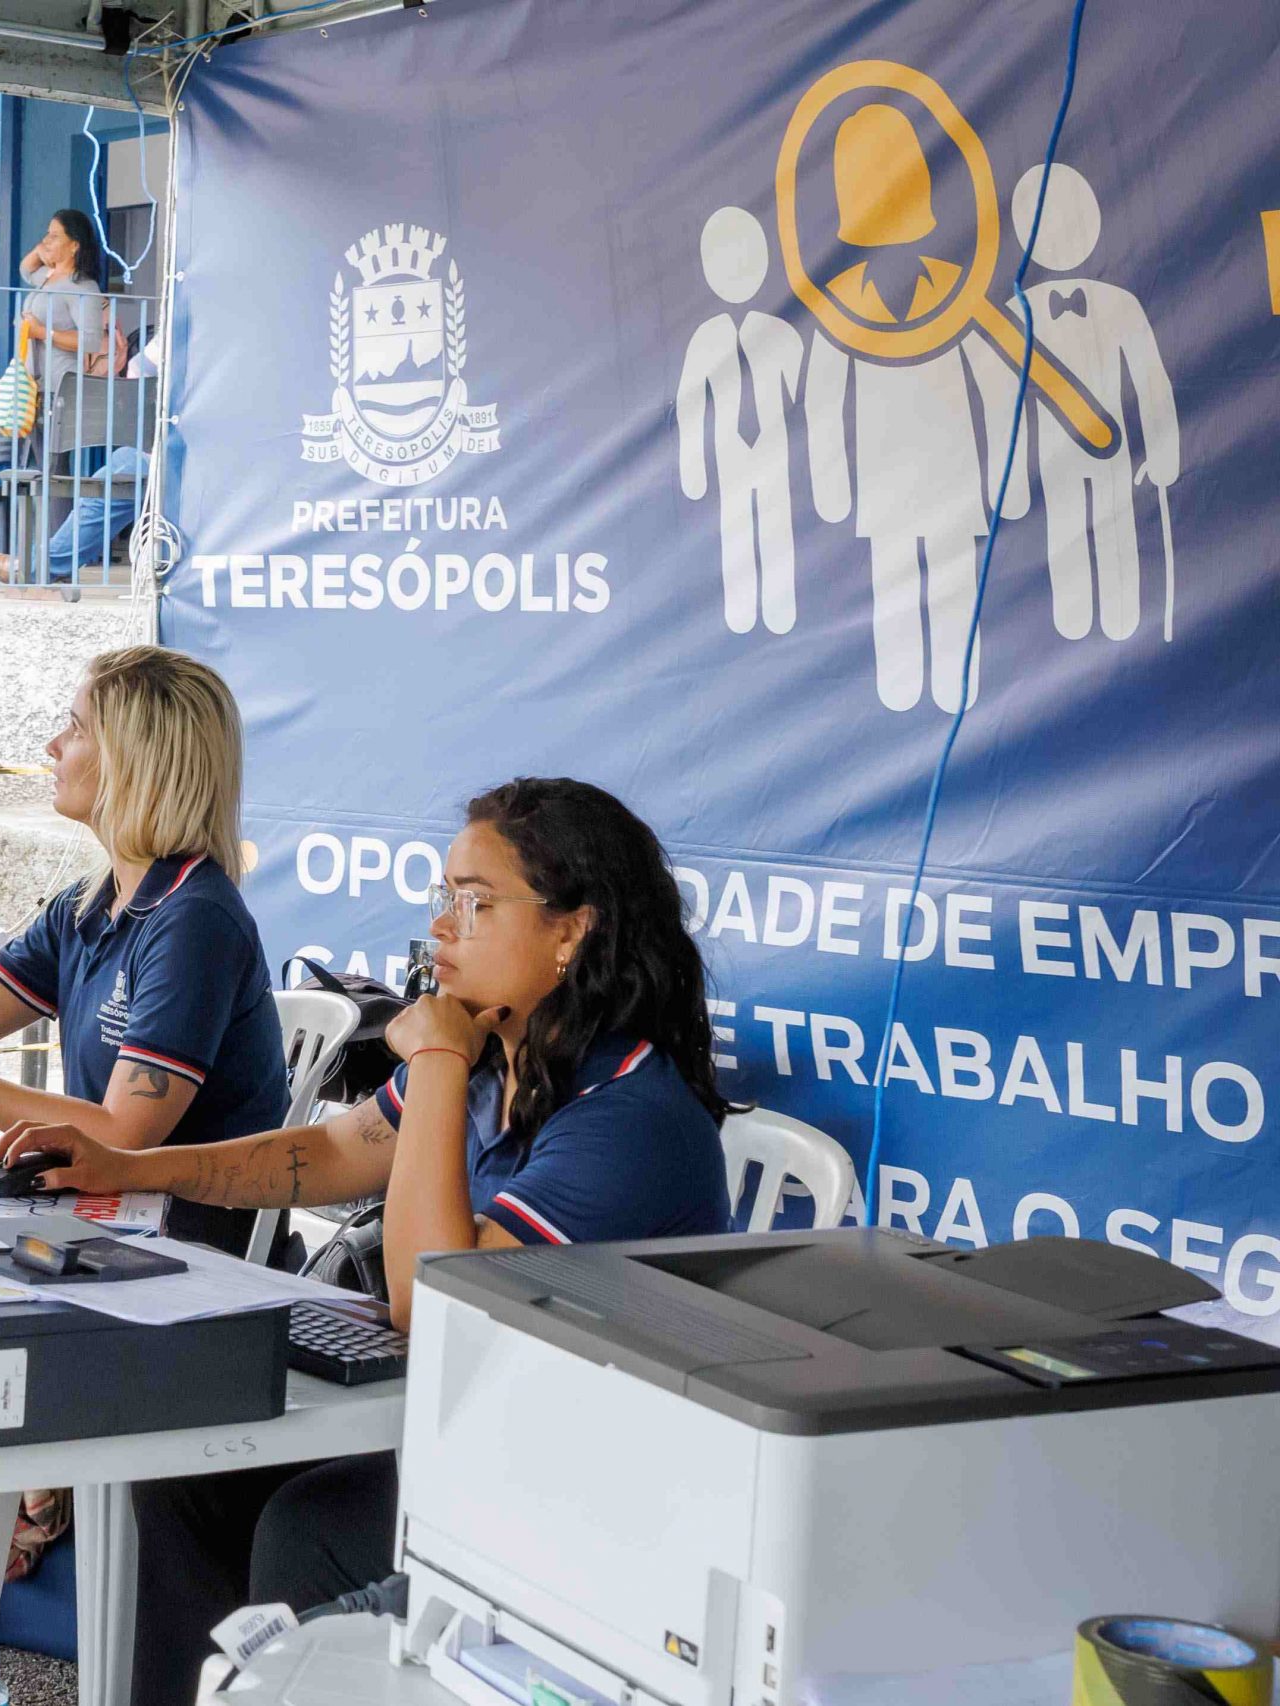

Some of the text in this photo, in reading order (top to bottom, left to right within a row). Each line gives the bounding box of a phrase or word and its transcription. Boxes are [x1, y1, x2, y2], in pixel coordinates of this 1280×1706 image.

[470, 411, 493, 424] 1891
[307, 438, 493, 485] SUB DIGITUM DEI
[292, 496, 508, 531] PREFEITURA
[191, 536, 611, 613] TERESÓPOLIS
[882, 888, 996, 970] DE
[753, 1005, 1265, 1143] TRABALHO
